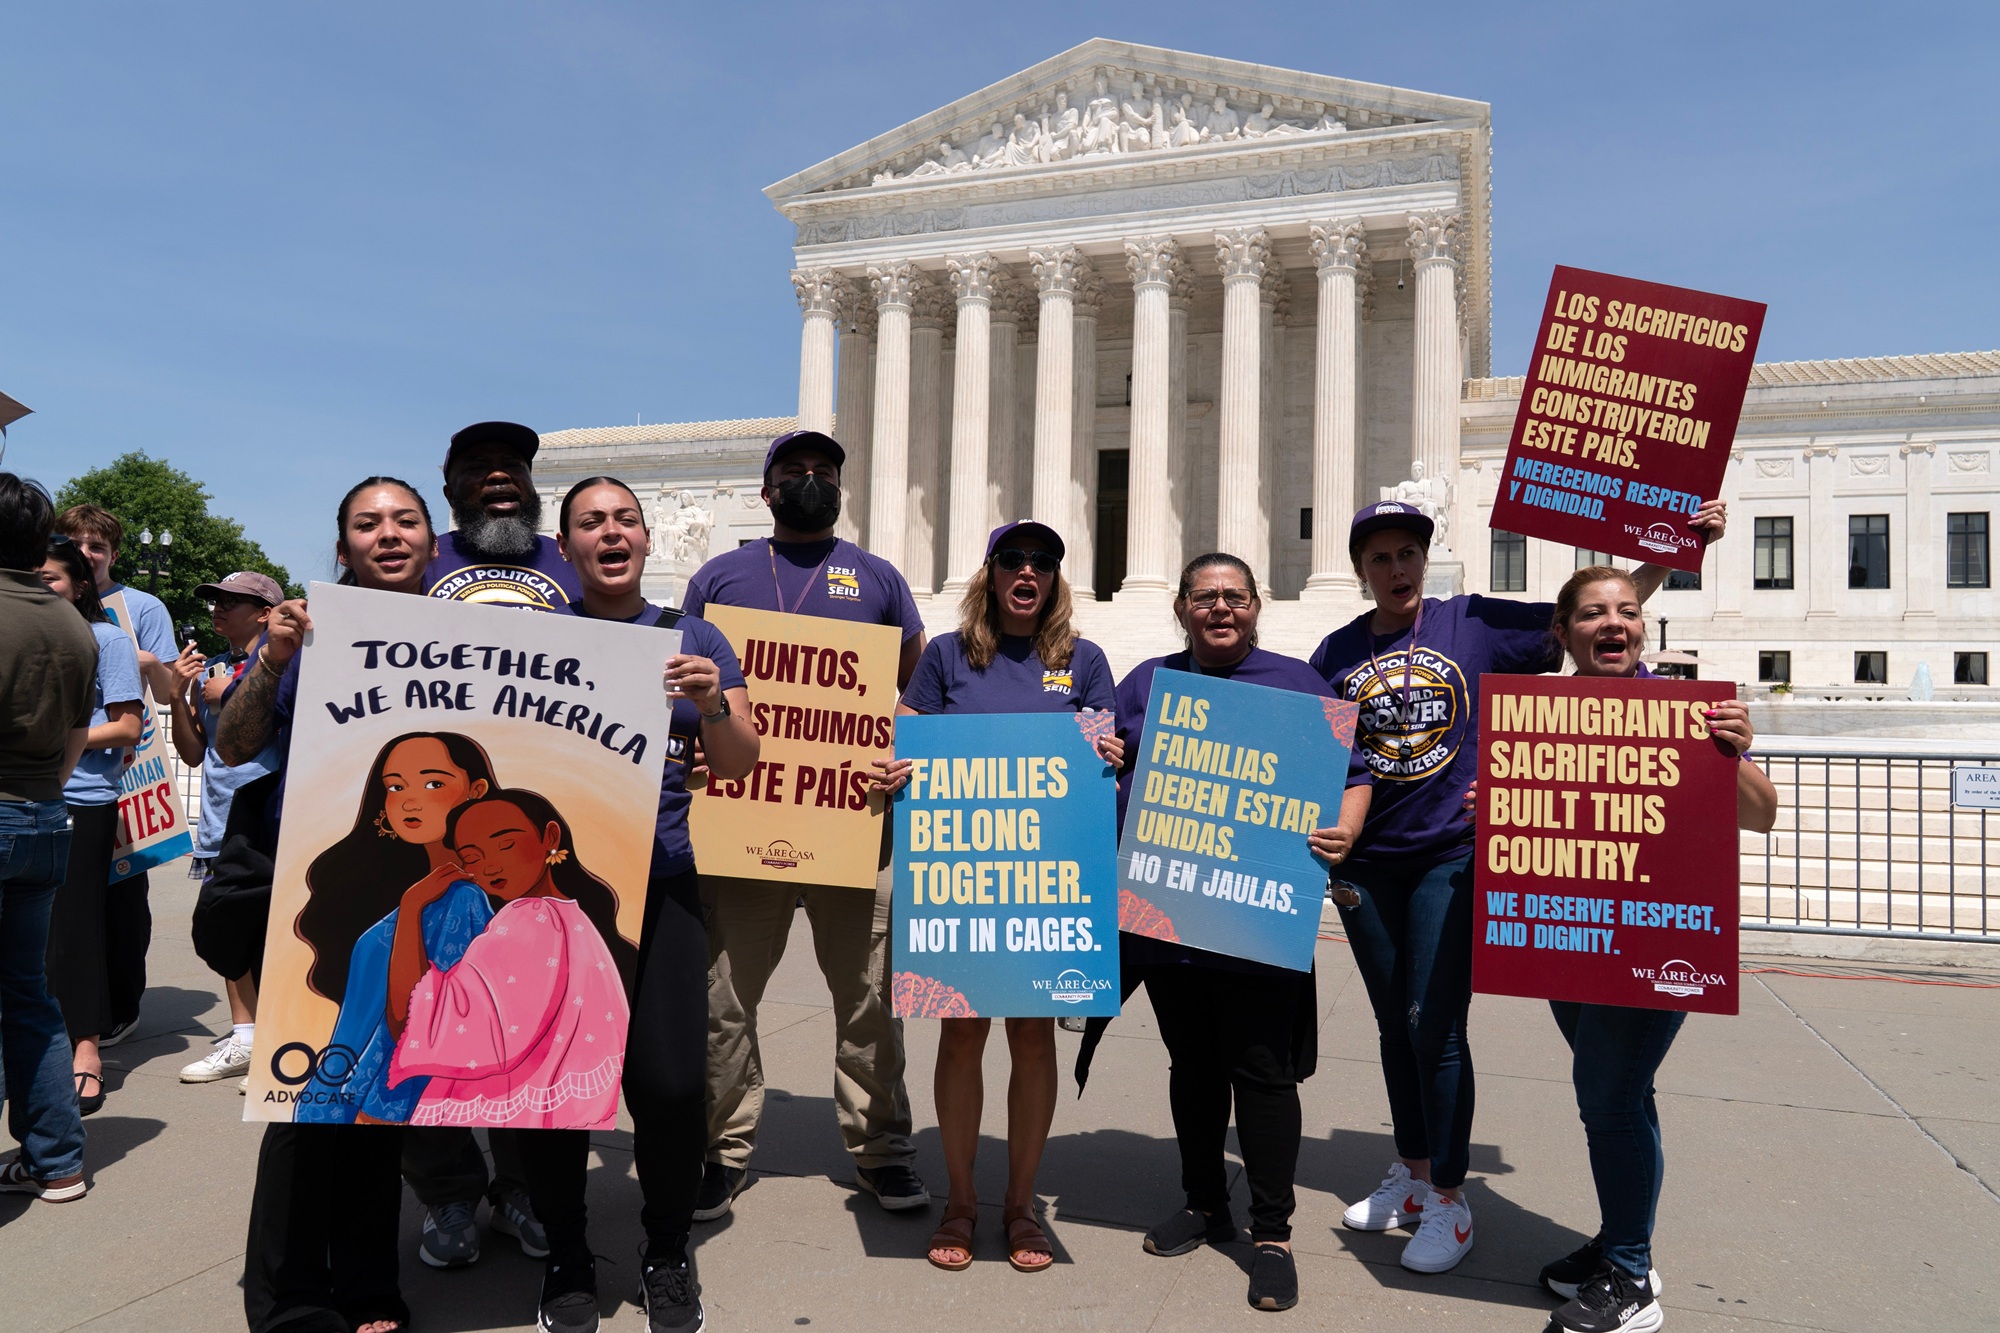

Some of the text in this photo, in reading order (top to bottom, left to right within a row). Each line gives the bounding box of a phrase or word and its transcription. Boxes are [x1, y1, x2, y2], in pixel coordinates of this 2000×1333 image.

[1546, 322, 1629, 363] DE LOS
[1554, 290, 1749, 353] LOS SACRIFICIOS
[1537, 354, 1698, 411] INMIGRANTES
[1530, 387, 1711, 449] CONSTRUYERON
[1521, 418, 1641, 470] ESTE PAÍS.
[1508, 480, 1607, 522] Y DIGNIDAD.
[1513, 456, 1702, 515] MERECEMOS RESPETO
[1624, 524, 1643, 536] WE
[1644, 530, 1668, 541] ARE
[1669, 534, 1697, 549] CASA
[436, 569, 556, 600] 32BJ POLITICAL
[459, 584, 486, 599] BUILDING
[516, 586, 537, 600] POWER
[827, 565, 856, 576] 32BJ
[827, 586, 860, 597] SEIU
[351, 640, 595, 691] TOGETHER,
[737, 639, 867, 697] JUNTOS,
[1348, 666, 1375, 696] 32BJ
[1379, 654, 1451, 678] POLTICAL
[1043, 685, 1071, 695] SEIU
[1159, 692, 1210, 731] LAS
[1369, 695, 1392, 709] WE
[324, 679, 648, 765] WE ARE AMERICA
[749, 701, 891, 750] STRUIMOS
[1360, 700, 1447, 731] POWER
[911, 756, 1068, 799] FAMILIES
[1151, 731, 1278, 786] FAMILIAS
[1361, 743, 1449, 774] ORGANIZERS
[1490, 741, 1681, 787] SACRIFICES
[1966, 773, 1997, 783] AREA
[794, 760, 869, 811] PAÍS
[1143, 770, 1321, 836] DEBEN ESTAR
[115, 781, 175, 850] TIES
[910, 808, 1040, 851] BELONG
[1489, 787, 1666, 835] BUILT THIS
[746, 846, 763, 855] WE
[765, 848, 787, 857] ARE
[789, 850, 815, 860] CASA
[1136, 809, 1239, 862] UNIDAS.
[1488, 834, 1650, 883] COUNTRY.
[909, 860, 1091, 905] TOGETHER.
[1128, 851, 1298, 915] NO EN JAULAS.
[1486, 890, 1721, 935] WE DESERVE RESPECT,
[909, 917, 1102, 953] NOT IN CAGES.
[1485, 920, 1621, 955] AND DIGNITY.
[1032, 979, 1112, 990] WE ARE CASA
[1631, 967, 1655, 979] WE
[1658, 970, 1688, 982] ARE
[1690, 972, 1727, 986] CASA
[263, 1090, 356, 1105] ADVOCATE
[1617, 1301, 1640, 1325] HOKA
